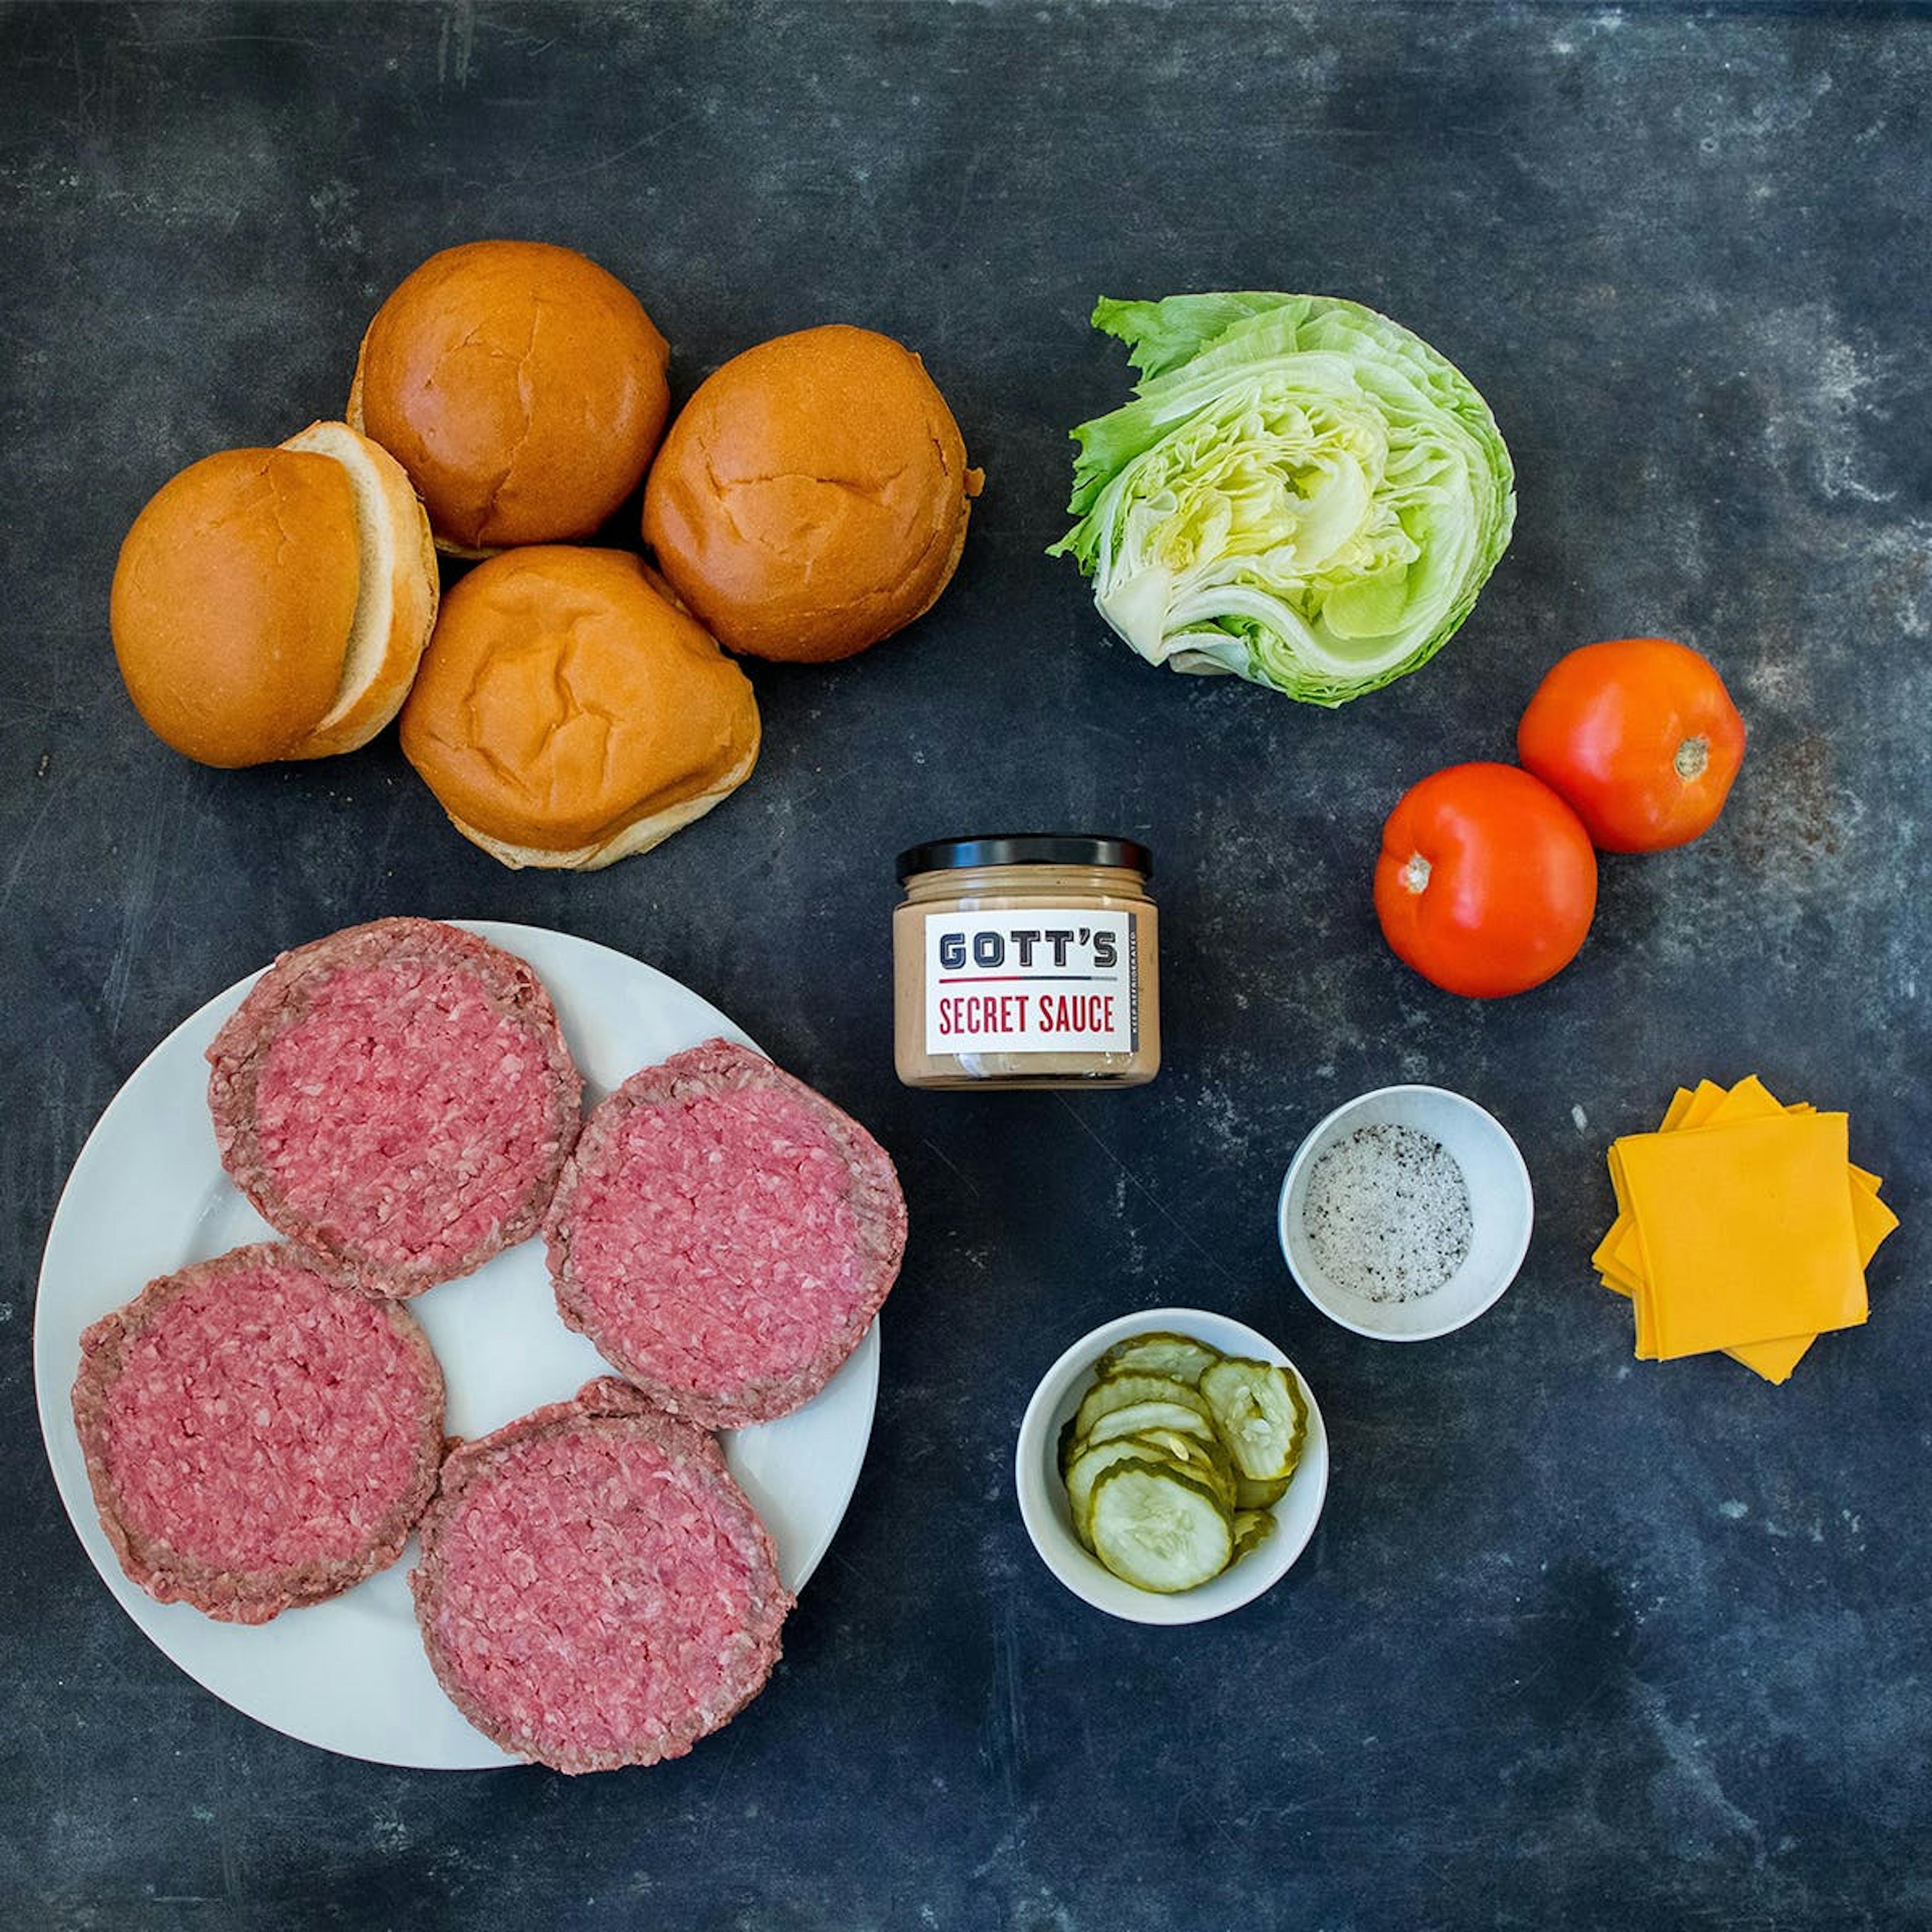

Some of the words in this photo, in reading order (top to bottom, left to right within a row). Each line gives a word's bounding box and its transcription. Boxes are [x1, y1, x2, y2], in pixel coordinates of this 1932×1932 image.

[939, 928, 1117, 970] GOTT'S
[939, 995, 1029, 1035] SECRET
[1039, 995, 1114, 1032] SAUCE
